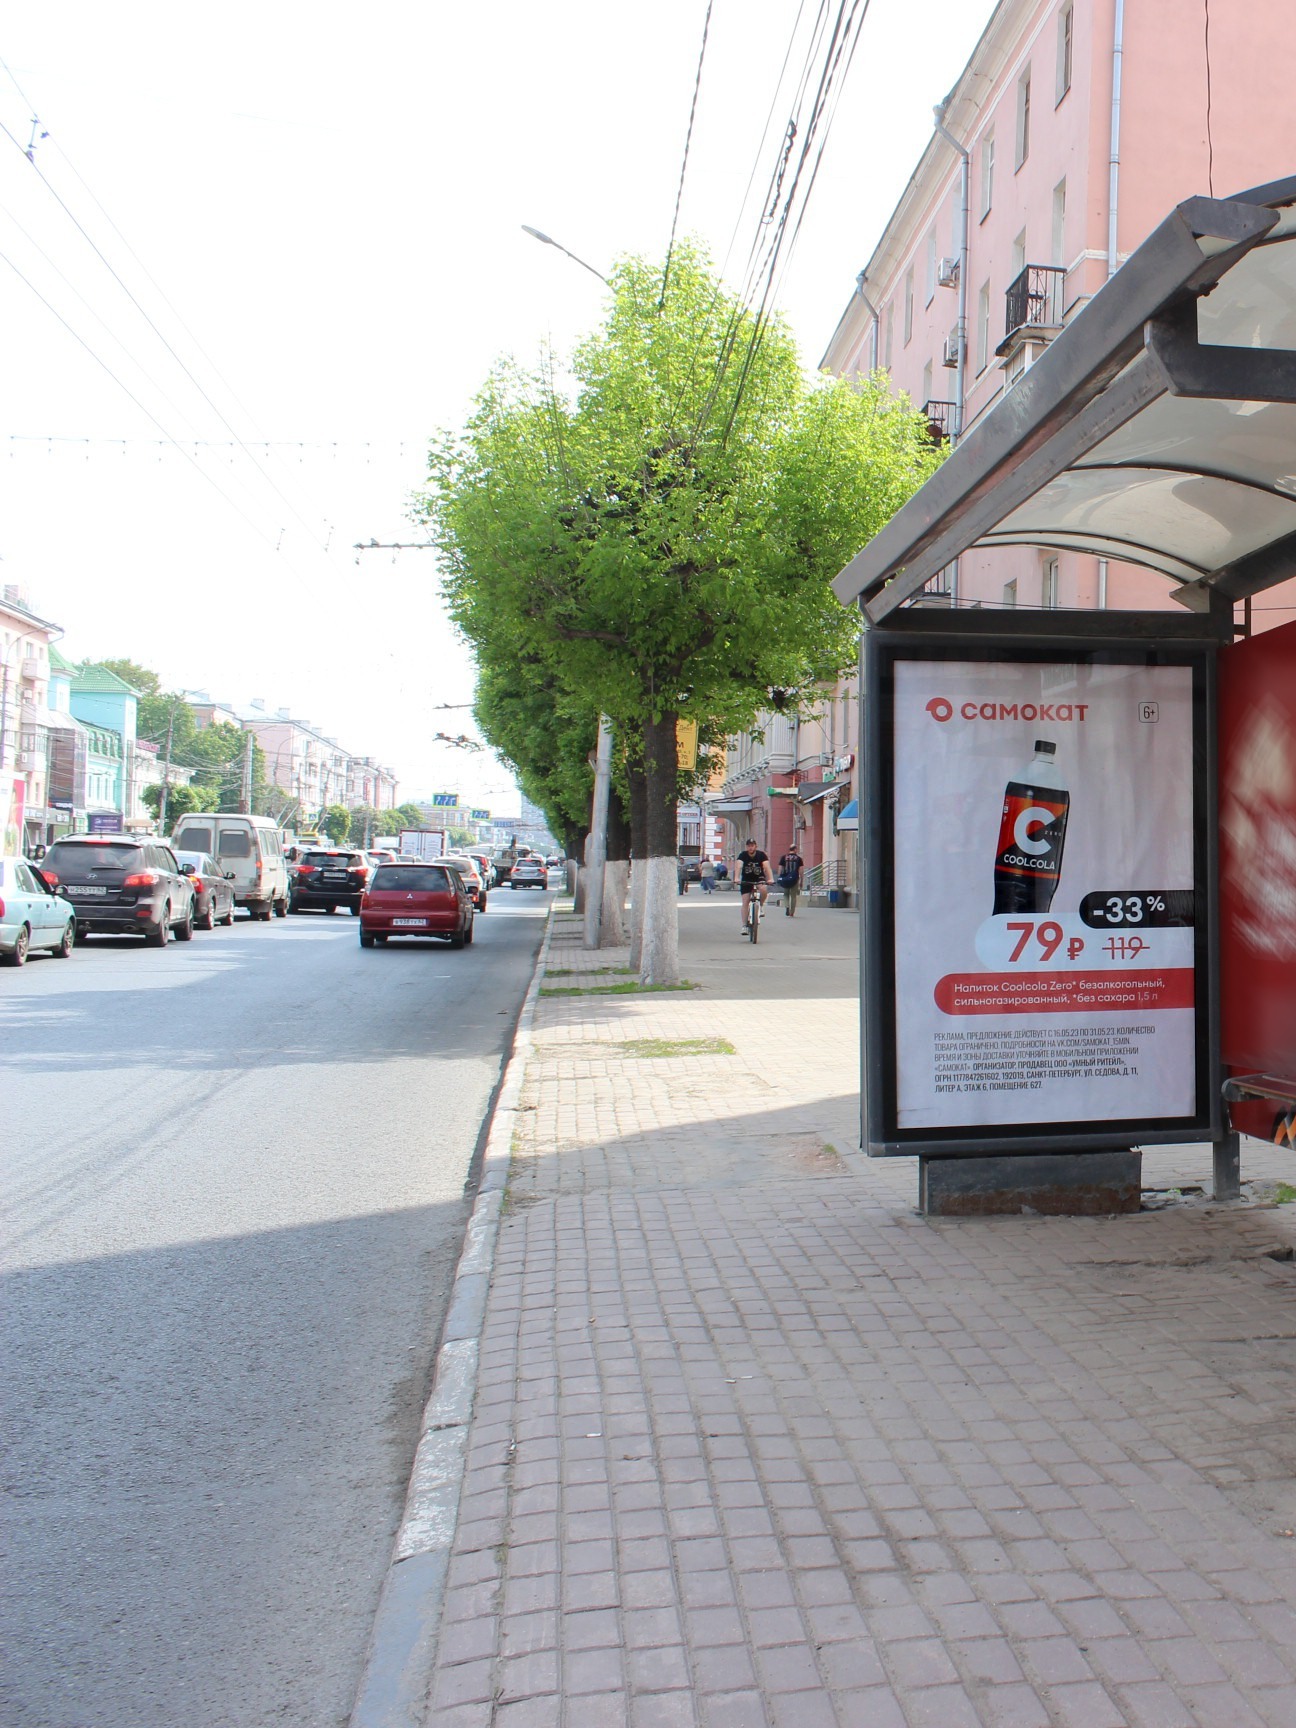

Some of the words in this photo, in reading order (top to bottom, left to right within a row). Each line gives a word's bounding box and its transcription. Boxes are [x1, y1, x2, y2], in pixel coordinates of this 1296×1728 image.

[1142, 705, 1156, 720] 6+
[1003, 854, 1055, 870] COOLCOLA
[1104, 937, 1147, 960] 119
[954, 983, 999, 993] Напиток
[1001, 981, 1048, 992] Coolcola
[1079, 978, 1166, 989] безалкогольный,
[954, 993, 1070, 1006] сильногазированный,
[1097, 994, 1136, 1003] сахара
[966, 1030, 1012, 1041] ПРЕДЛОЖЕНИЕ
[1014, 1028, 1047, 1039] ДЕЙСТВУЕТ
[1048, 1029, 1053, 1038] С
[1080, 1028, 1089, 1037] ПО
[1116, 1026, 1155, 1035] КОЛИЧЕСТВО
[934, 1042, 958, 1052] ТОВАРА
[1000, 1040, 1046, 1050] ПОДРОБНОСТИ
[1047, 1039, 1056, 1048] НА
[934, 1053, 956, 1062] ВРЕМЯ
[957, 1053, 962, 1061] И
[963, 1052, 981, 1061] ЗОНЫ
[982, 1051, 1015, 1061] ДОСТАВКИ
[1015, 1049, 1049, 1060] УТОЧНЯЙТЕ
[1050, 1049, 1055, 1057] В
[1056, 1048, 1096, 1058] МОБИЛЬНОМ
[1096, 1047, 1139, 1057] ПРИЛОЖЕНИИ
[1017, 1060, 1053, 1070] ПРОДАВЕЦ
[1054, 1059, 1068, 1068] ООО
[1068, 1057, 1096, 1068] «УМНЫЙ
[934, 1074, 952, 1083] ОГРН
[934, 1084, 956, 1093] ЛИТЕР
[963, 1083, 981, 1092] ЭТАЖ
[989, 1081, 1029, 1092] ПОМЕЩЕНИЕ
